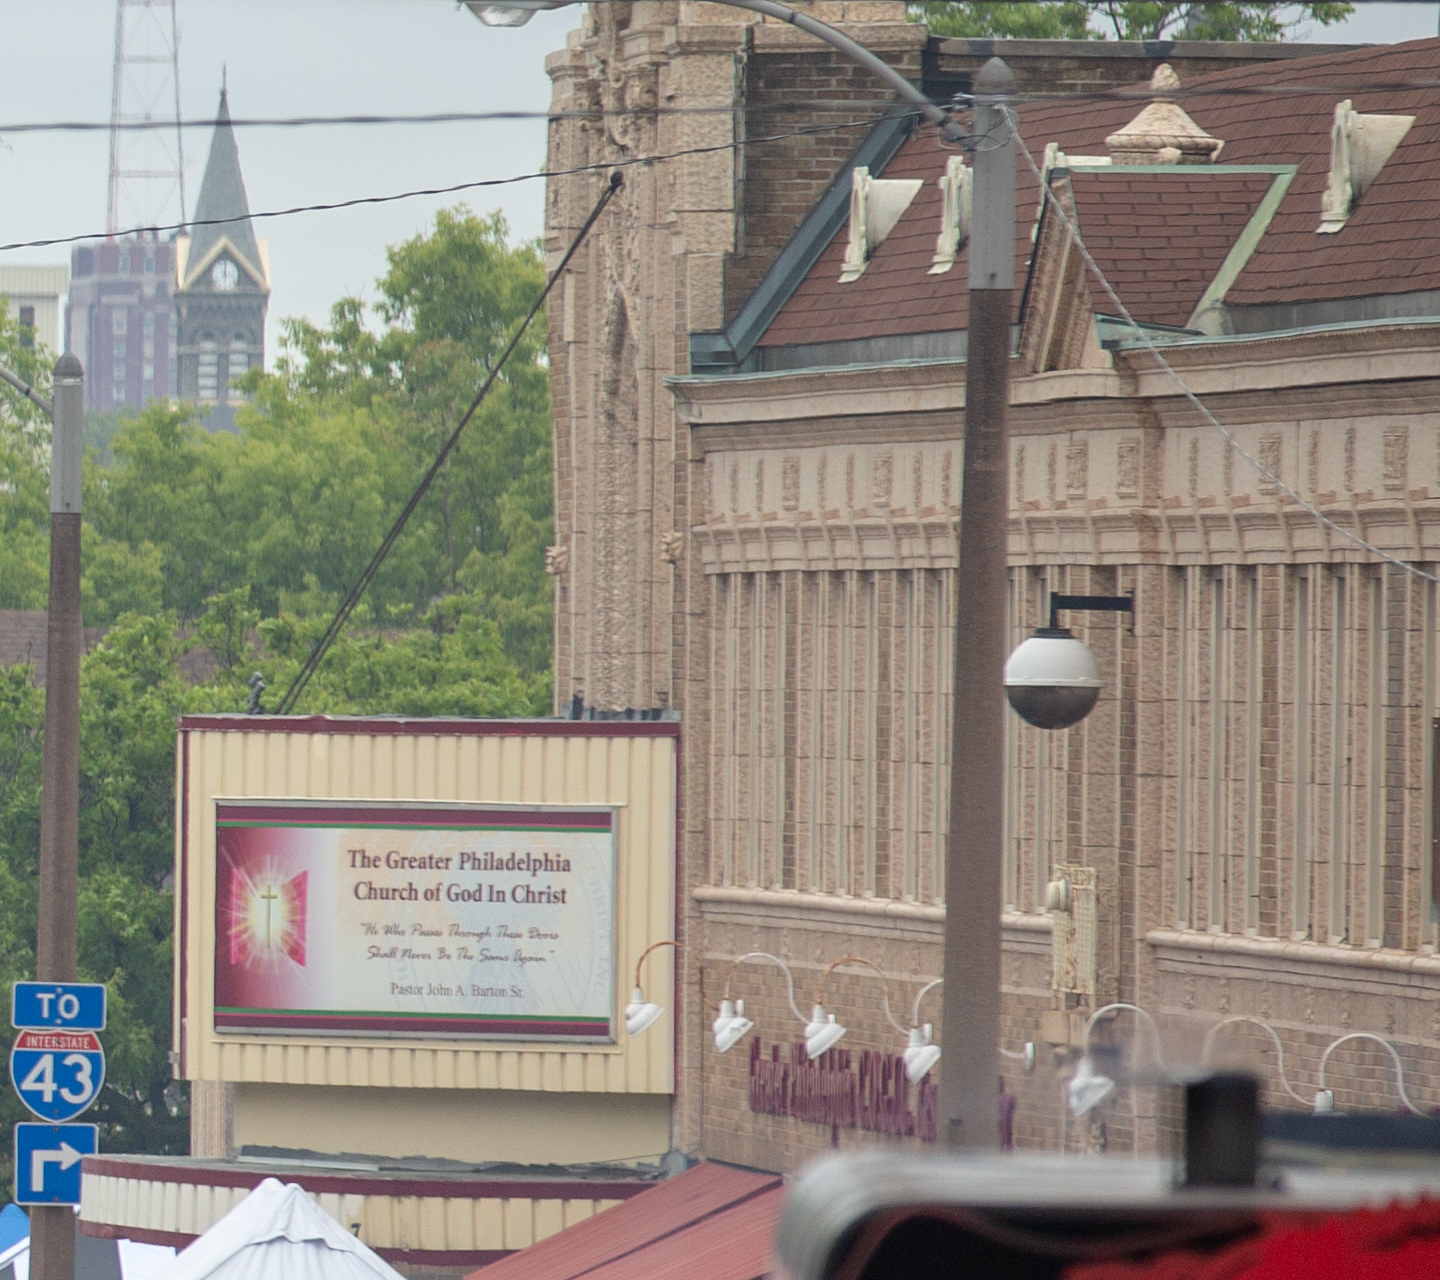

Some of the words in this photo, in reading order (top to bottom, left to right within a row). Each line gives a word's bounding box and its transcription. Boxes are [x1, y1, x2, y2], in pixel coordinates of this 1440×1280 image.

[348, 849, 381, 869] The
[385, 851, 452, 870] Greater
[459, 852, 572, 877] Philadelphia
[354, 881, 418, 901] Church
[423, 883, 443, 902] of
[447, 883, 483, 903] God
[488, 884, 507, 903] In
[512, 885, 567, 904] Christ
[383, 923, 406, 937] Who
[448, 923, 491, 943] Through
[496, 925, 523, 939] These
[528, 926, 560, 939] Doors
[367, 945, 397, 960] Shall
[401, 948, 431, 961] Never
[437, 947, 452, 961] Be
[455, 947, 474, 961] The
[479, 948, 509, 963] Same
[390, 982, 424, 996] Pastor
[427, 983, 453, 997] John
[455, 984, 468, 997] A.
[472, 984, 508, 997] Barton
[36, 993, 80, 1019] TO
[26, 1035, 91, 1050] INTERSTATE
[20, 1053, 94, 1105] 43
